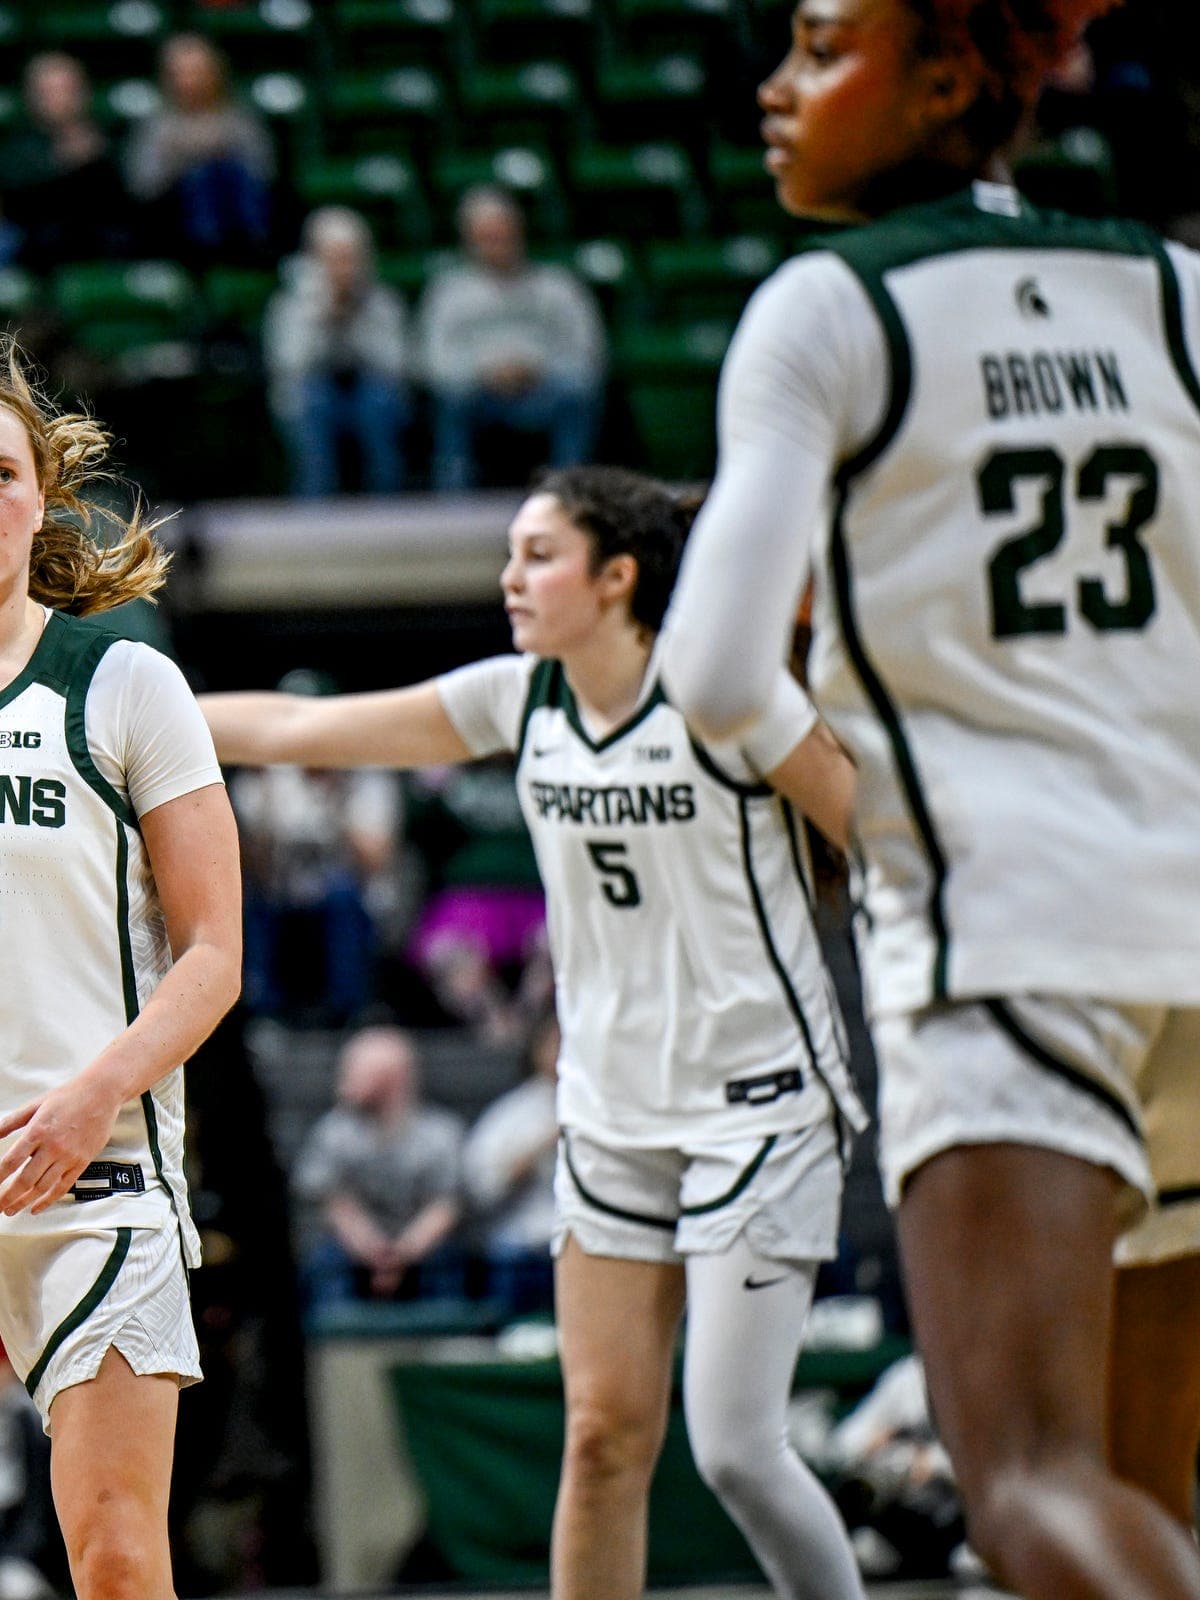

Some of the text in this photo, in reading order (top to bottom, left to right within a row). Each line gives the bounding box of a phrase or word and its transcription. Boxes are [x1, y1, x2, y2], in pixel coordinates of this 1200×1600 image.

[980, 349, 1130, 420] BROWN
[974, 443, 1161, 641] 23
[531, 783, 696, 825] SPARTANS
[587, 841, 641, 908] 5
[116, 1172, 130, 1184] 46
